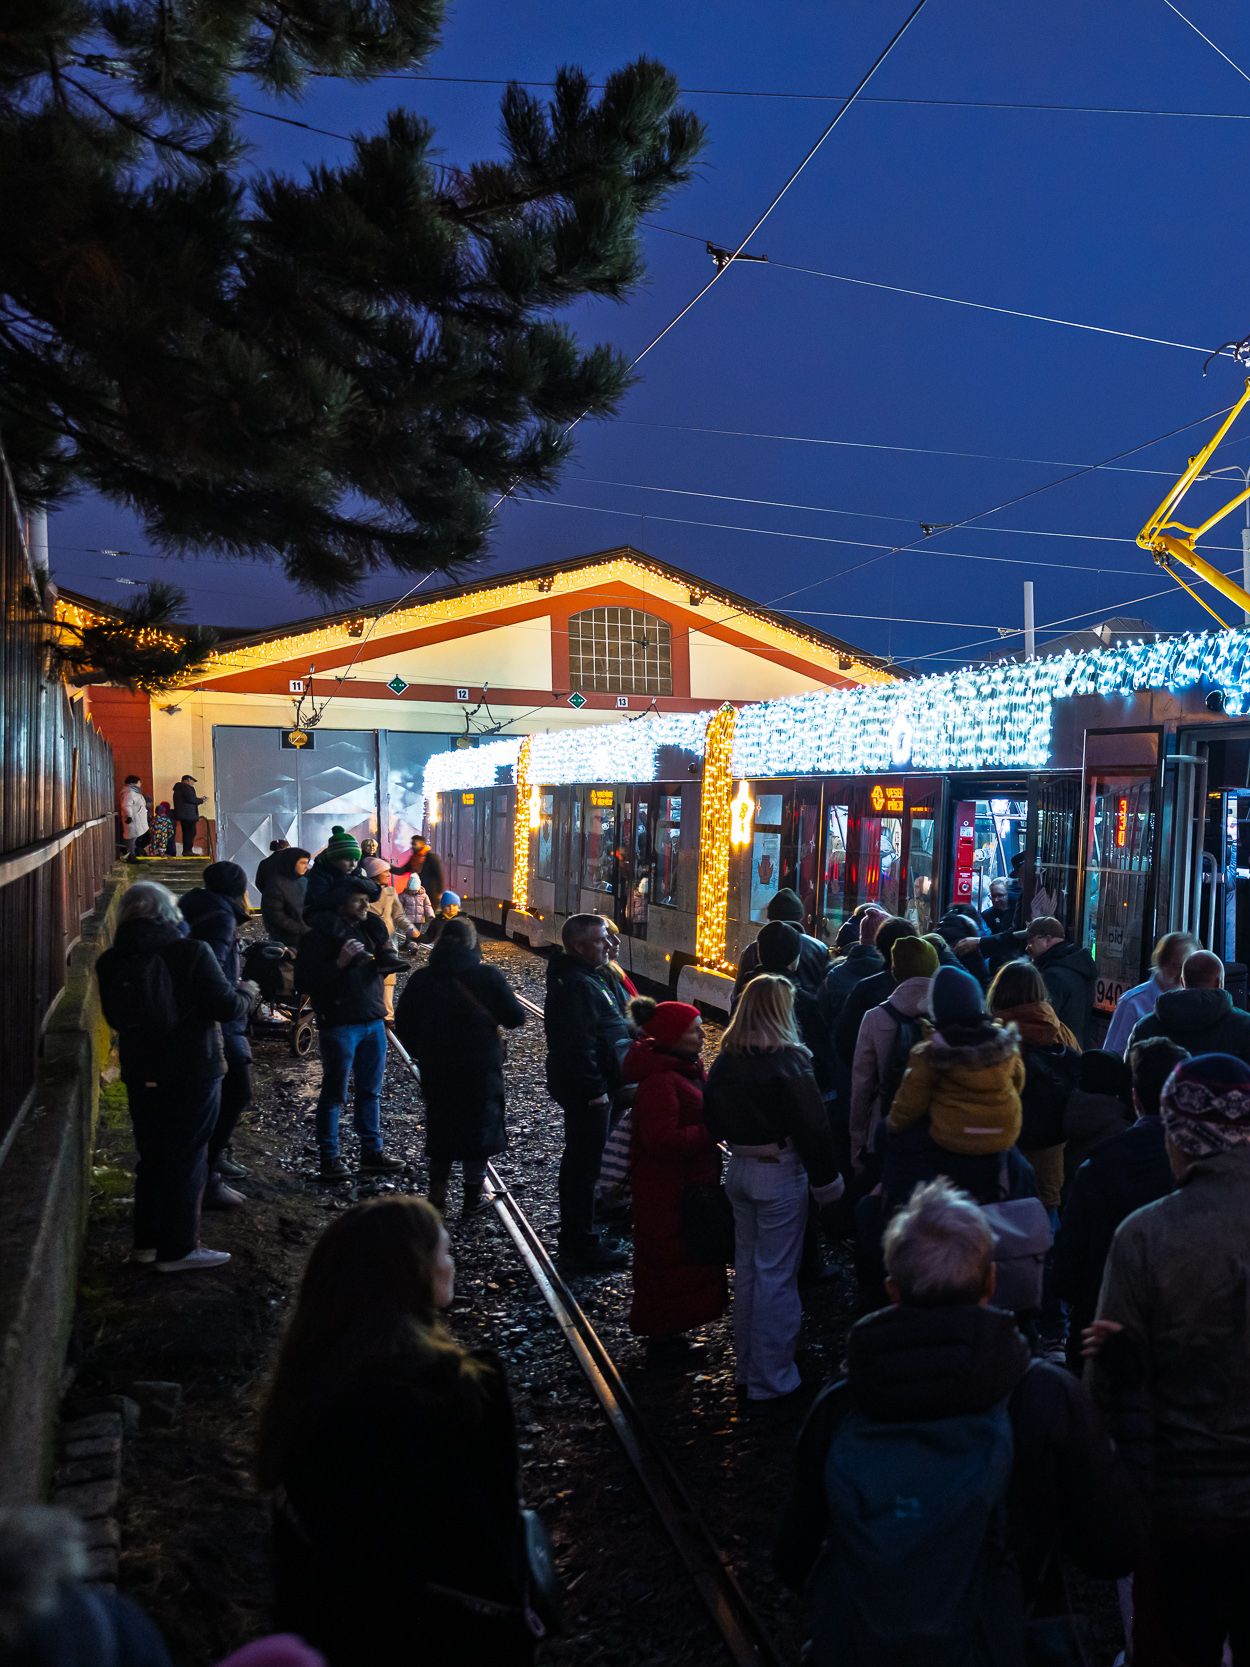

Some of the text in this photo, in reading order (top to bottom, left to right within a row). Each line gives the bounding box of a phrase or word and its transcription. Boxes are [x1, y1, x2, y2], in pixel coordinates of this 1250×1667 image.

[292, 682, 301, 690] 11
[458, 690, 467, 698] 12
[618, 698, 626, 706] 13
[886, 788, 904, 799] VESEL
[1108, 929, 1124, 944] pid
[1096, 981, 1130, 1006] 940
